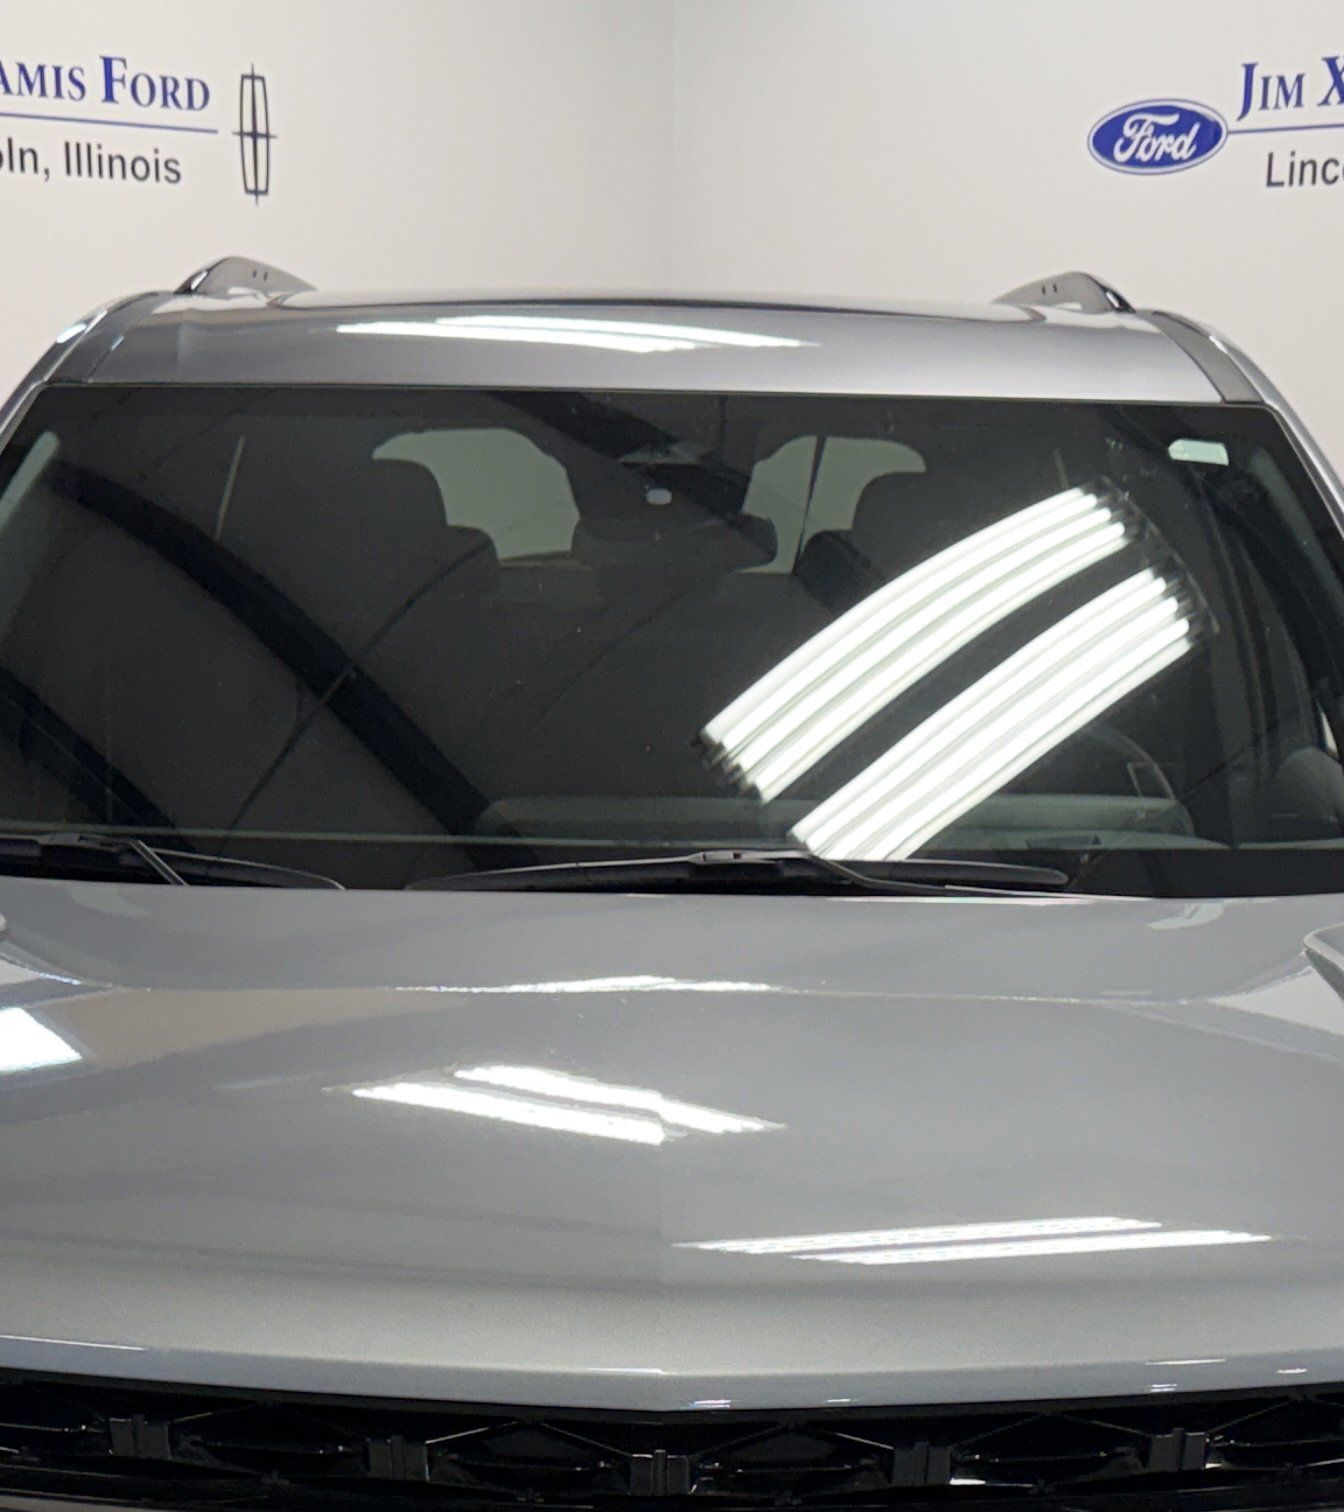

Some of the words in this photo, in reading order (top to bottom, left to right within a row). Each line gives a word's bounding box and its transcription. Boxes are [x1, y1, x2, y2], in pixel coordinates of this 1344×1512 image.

[100, 56, 211, 112] FORD
[1236, 62, 1306, 122] JIM
[64, 141, 183, 185] Illinois
[1113, 113, 1198, 162] Ford
